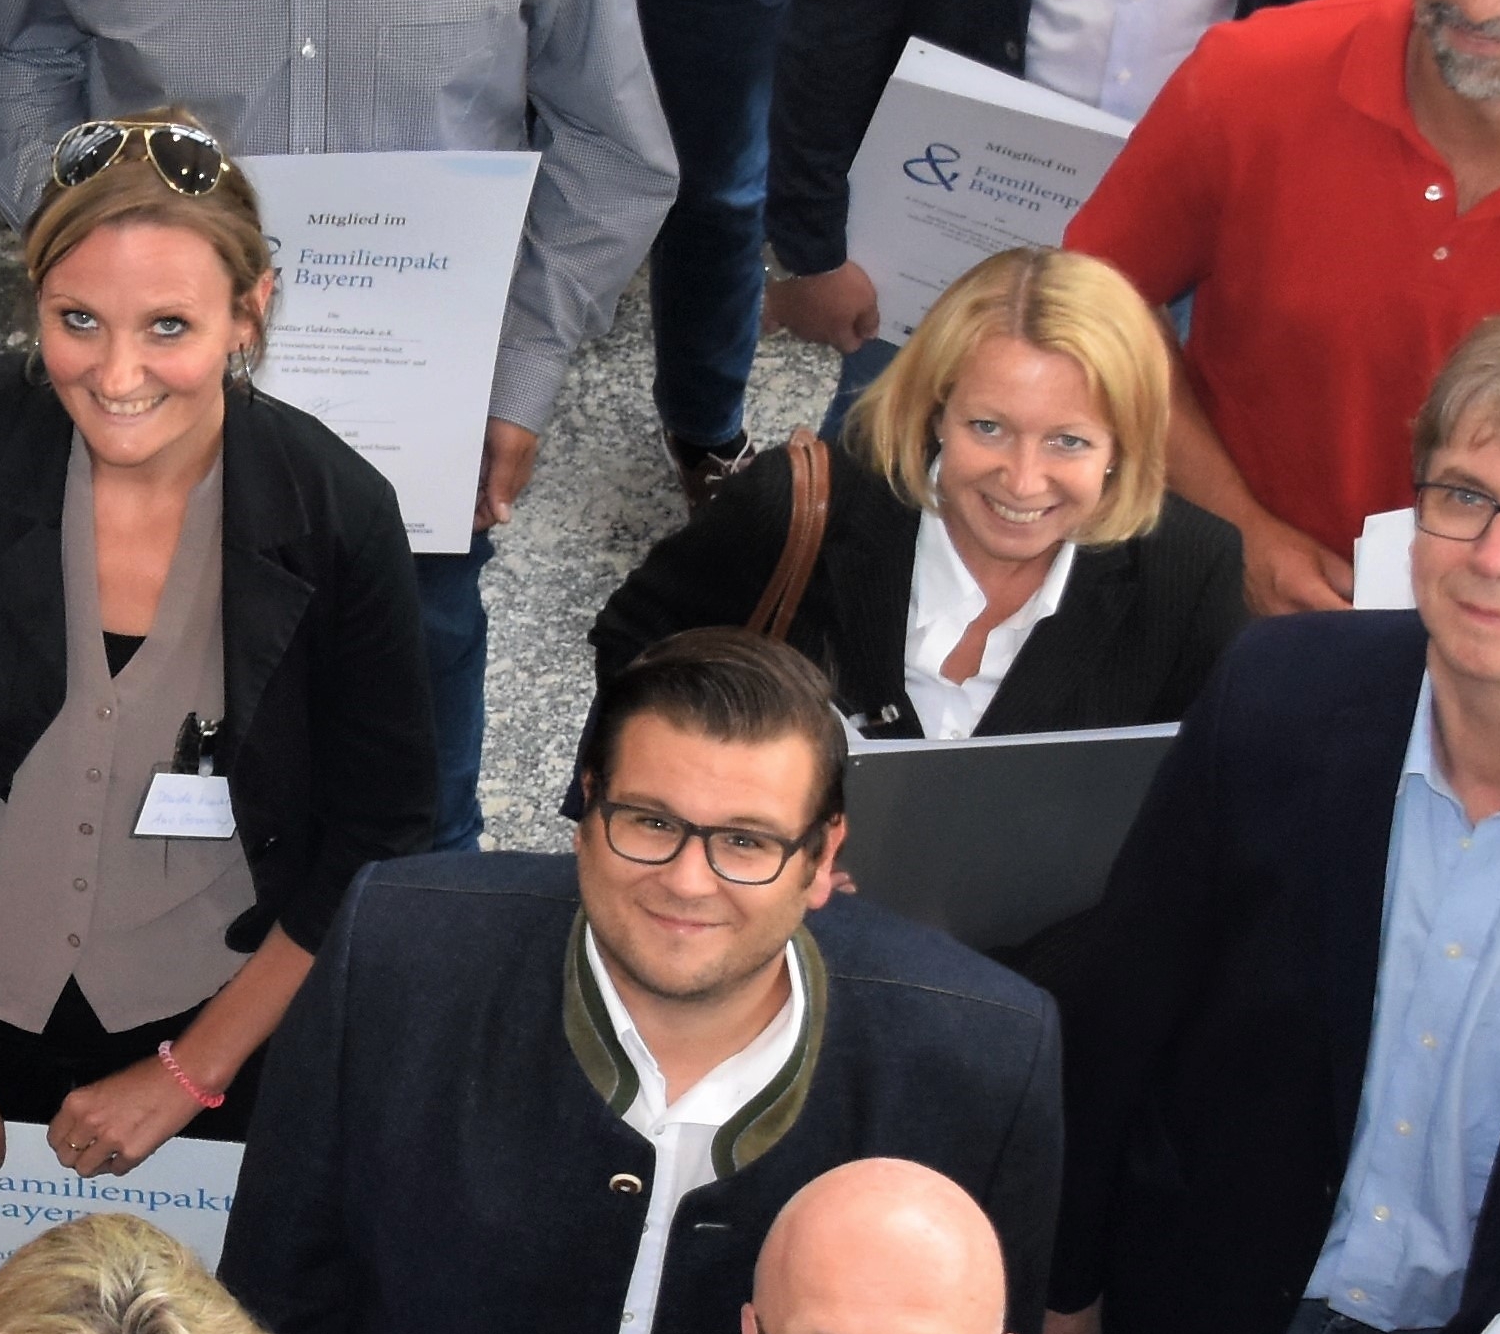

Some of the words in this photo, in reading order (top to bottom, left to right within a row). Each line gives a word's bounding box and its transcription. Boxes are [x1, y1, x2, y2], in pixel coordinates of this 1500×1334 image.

[985, 141, 1053, 169] Mitglied
[1056, 158, 1078, 176] im
[968, 179, 1041, 212] Bayern
[975, 165, 1079, 211] Familienp
[307, 213, 379, 228] Mitglied
[384, 214, 407, 226] im
[299, 248, 449, 274] Familienpakt
[294, 269, 373, 289] Bayern
